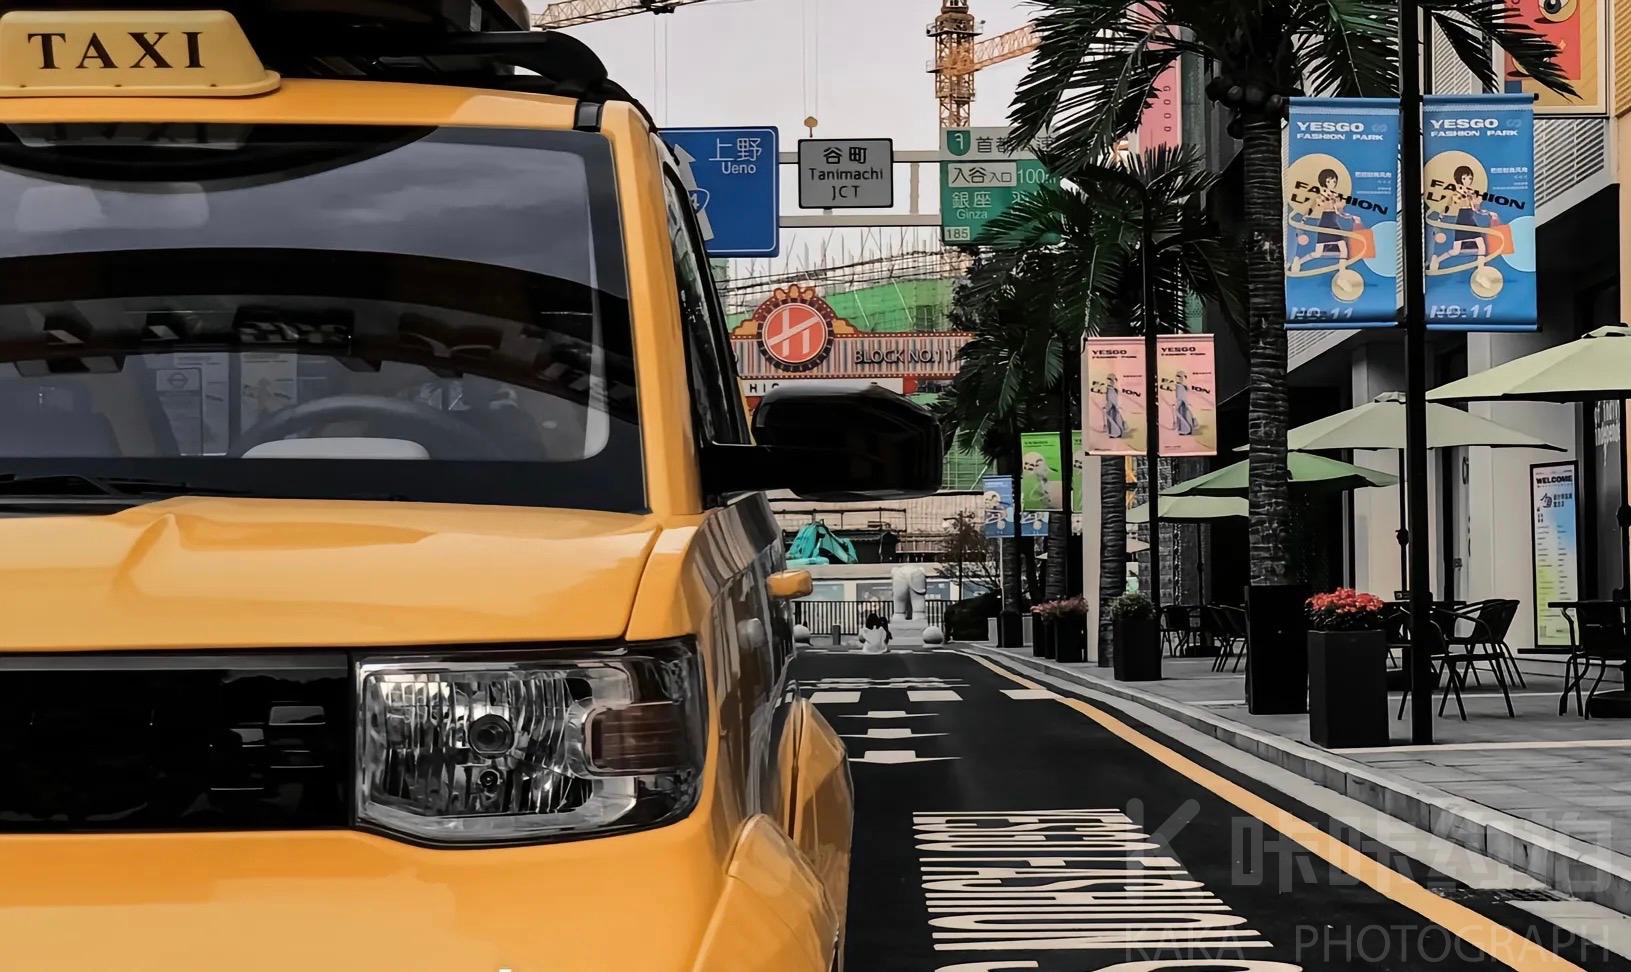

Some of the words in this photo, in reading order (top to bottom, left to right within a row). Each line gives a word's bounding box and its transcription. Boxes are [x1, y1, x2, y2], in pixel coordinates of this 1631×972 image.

[27, 31, 206, 70] TAXI
[1296, 121, 1365, 133] YESGO
[1430, 118, 1499, 129] YESGO
[1296, 133, 1346, 141] FASHION
[708, 137, 762, 161] 上野
[823, 146, 867, 165] 谷町
[721, 161, 757, 175] Ueno
[808, 167, 883, 181] Tanimachi
[831, 185, 861, 201] JCT
[951, 191, 993, 209] 銀座
[956, 208, 989, 221] Ginza
[945, 228, 970, 240] 185
[855, 350, 906, 365] BLOCK
[1536, 475, 1573, 485] WELCOME
